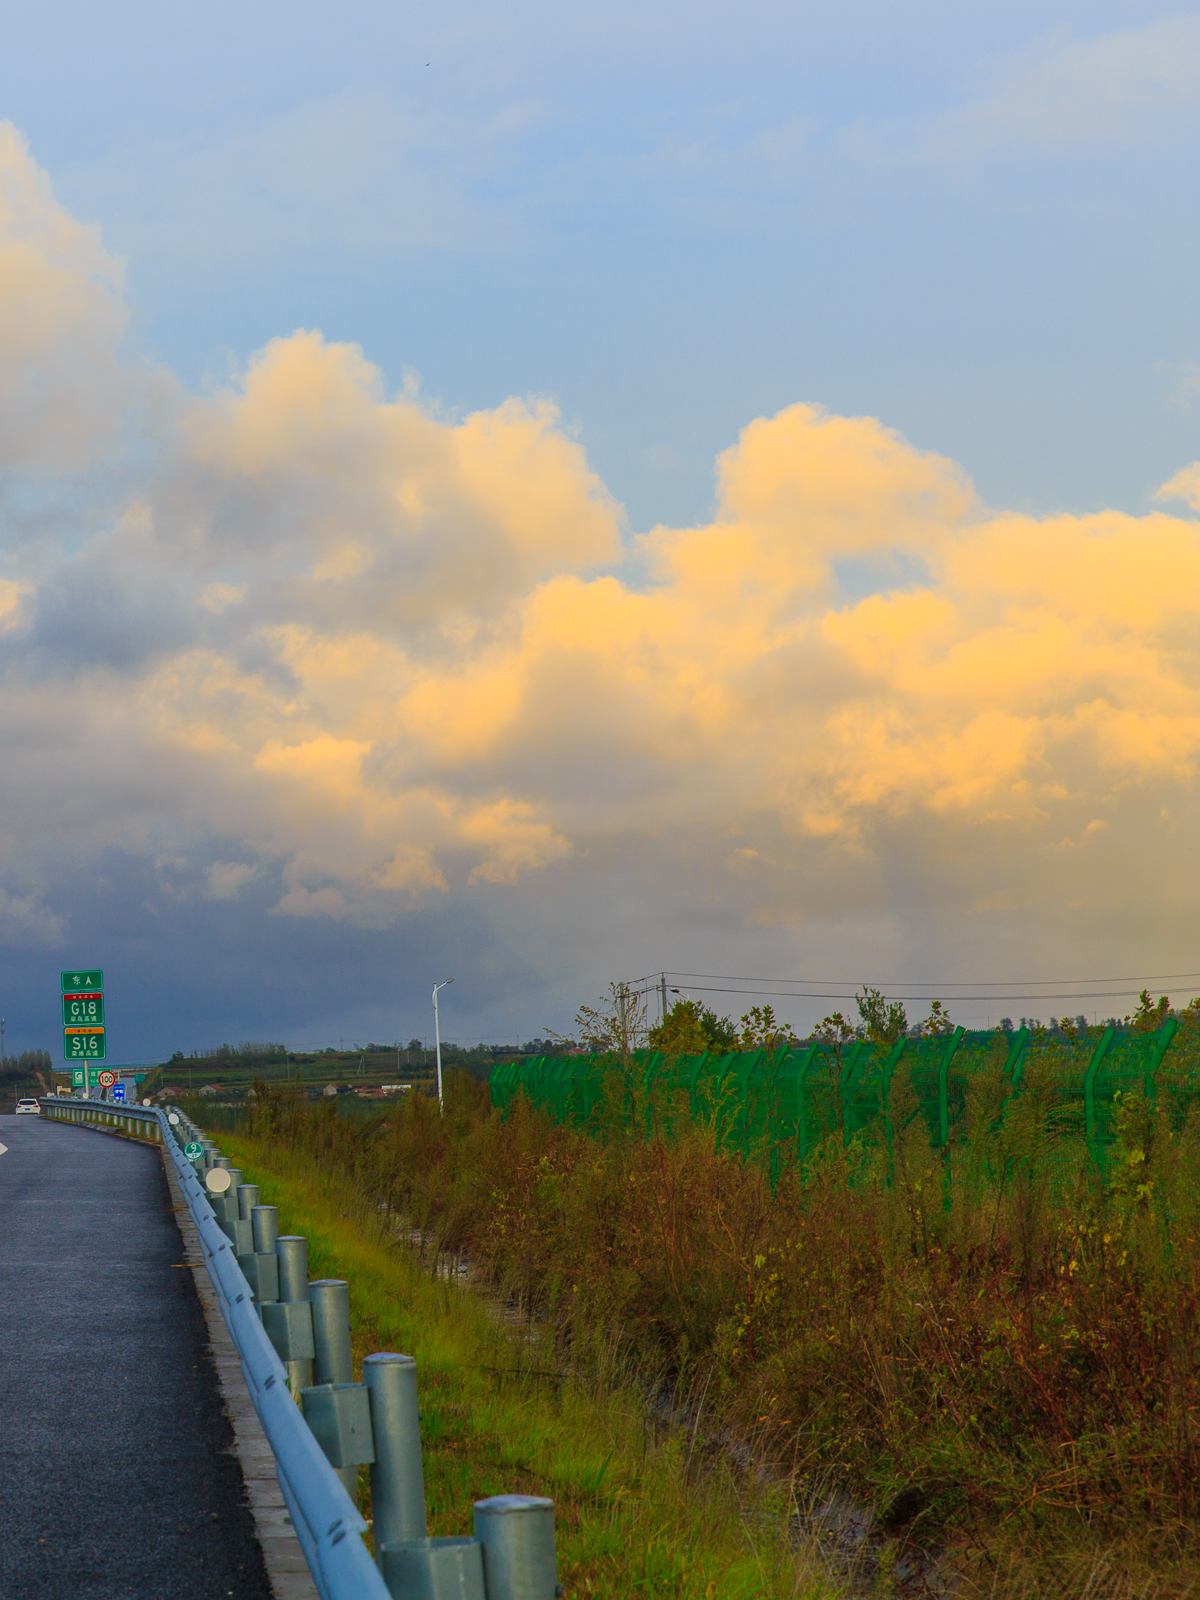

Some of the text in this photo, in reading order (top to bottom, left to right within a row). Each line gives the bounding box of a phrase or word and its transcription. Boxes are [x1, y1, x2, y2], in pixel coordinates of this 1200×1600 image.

[71, 1001, 96, 1015] G18
[72, 1036, 97, 1050] S16
[101, 1075, 113, 1083] 100
[190, 1143, 196, 1152] 9
